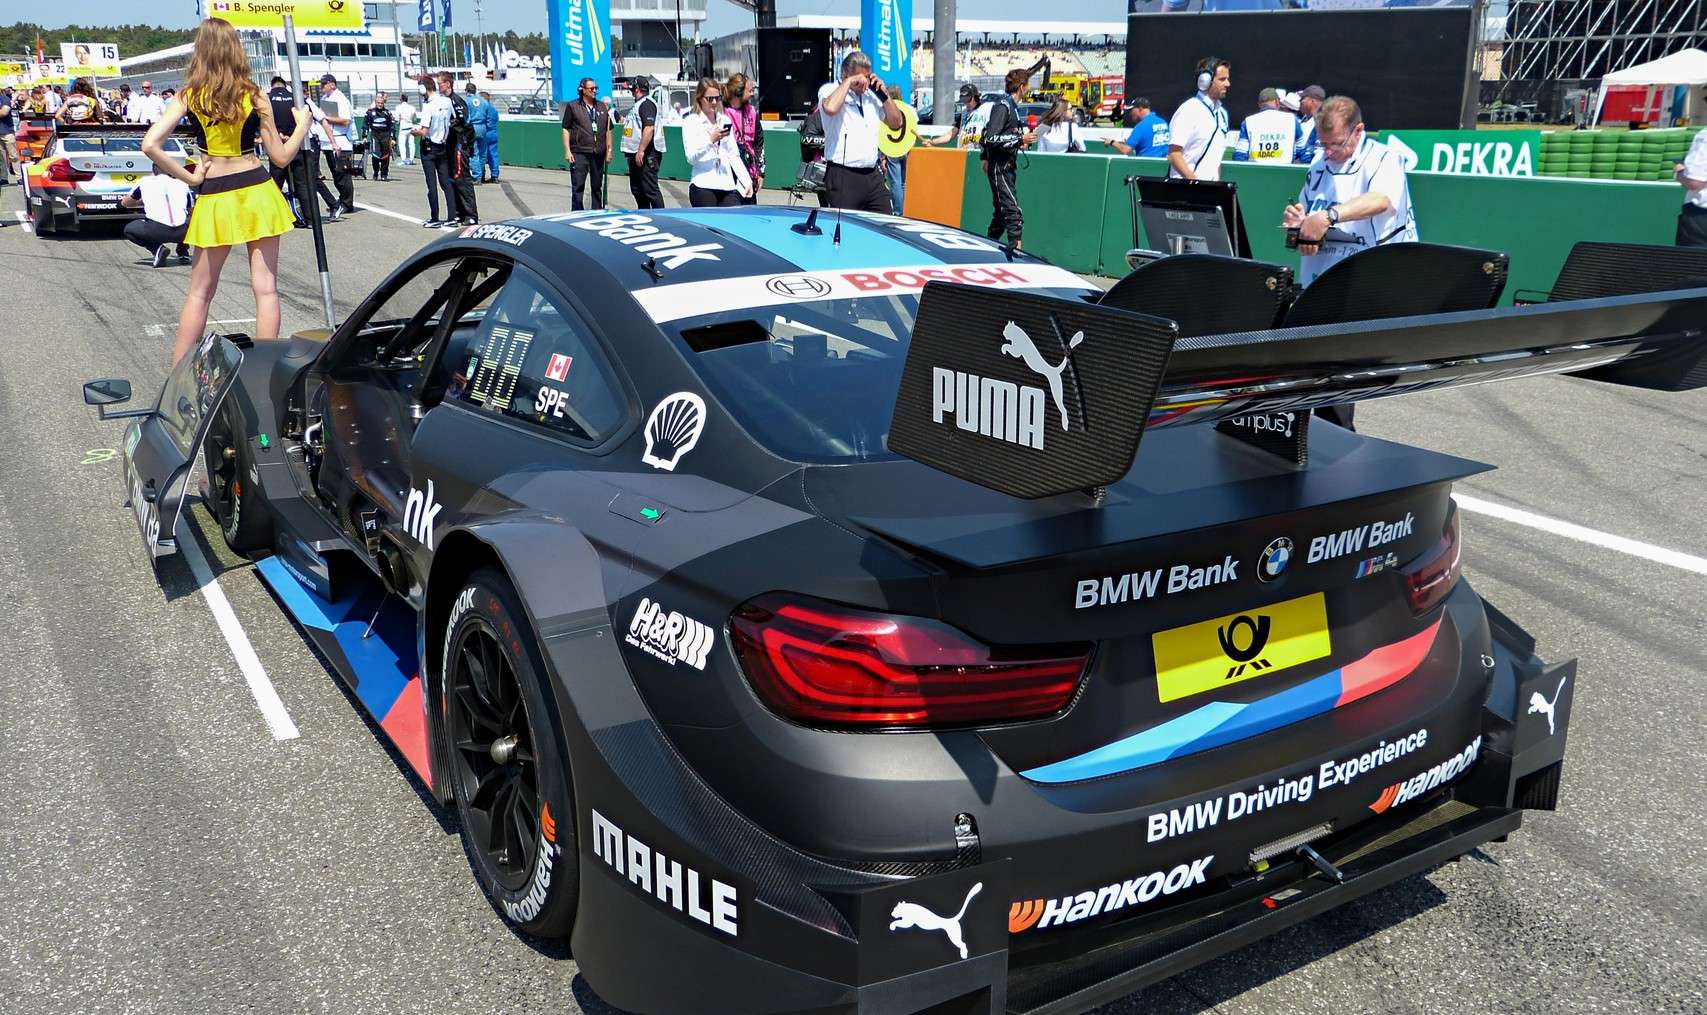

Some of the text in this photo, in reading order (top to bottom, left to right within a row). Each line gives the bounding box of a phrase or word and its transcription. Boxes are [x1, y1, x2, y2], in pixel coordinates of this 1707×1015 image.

[234, 2, 294, 15] B. Spengler
[56, 65, 65, 73] 22
[101, 46, 115, 59] 15
[1257, 150, 1275, 158] ADAC
[1258, 142, 1280, 151] 108
[1431, 141, 1533, 177] DEKRA
[473, 222, 534, 247] SPENGLER
[569, 213, 725, 271] Bank
[840, 266, 1030, 292] BOSCH
[535, 386, 570, 418] SPE
[932, 366, 1045, 451] PUMA
[1307, 512, 1417, 564] BMW Bank
[1075, 555, 1241, 609] BMW Bank
[630, 597, 687, 657] H&R
[1147, 728, 1427, 843] BMW Driving Experience
[592, 808, 738, 937] MAHLE
